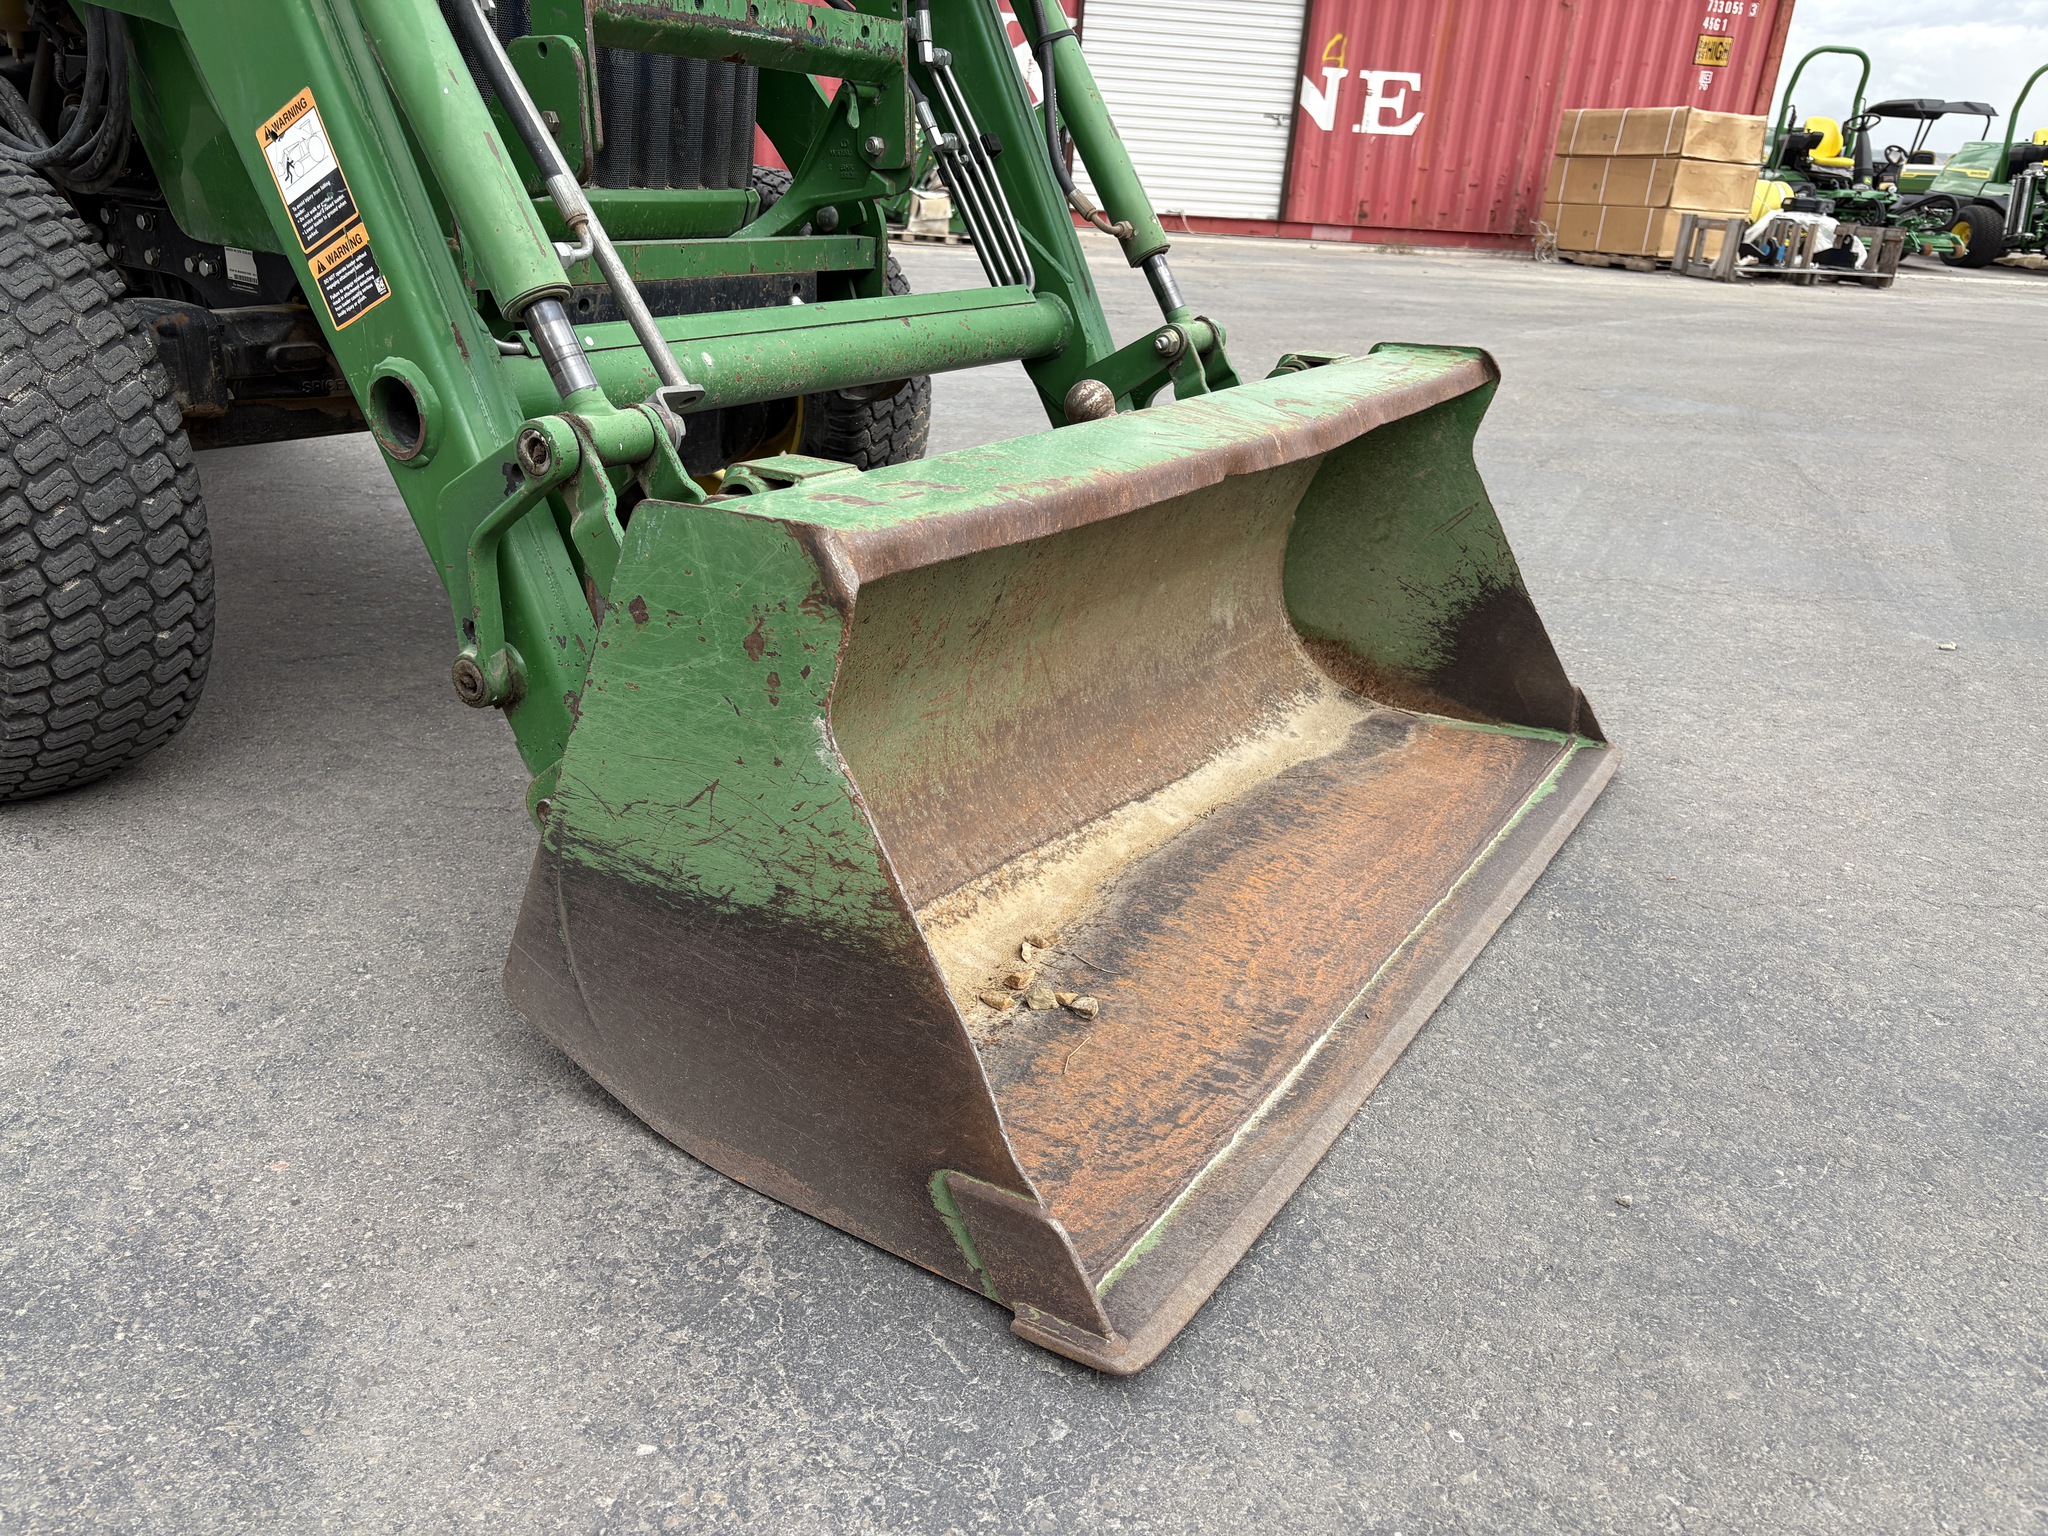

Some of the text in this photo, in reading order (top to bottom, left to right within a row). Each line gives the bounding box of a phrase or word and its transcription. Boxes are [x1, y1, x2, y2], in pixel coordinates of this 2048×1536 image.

[1749, 2, 1758, 16] 3
[1322, 33, 1347, 69] 4
[271, 97, 308, 132] WARNING
[325, 233, 363, 265] WARNING
